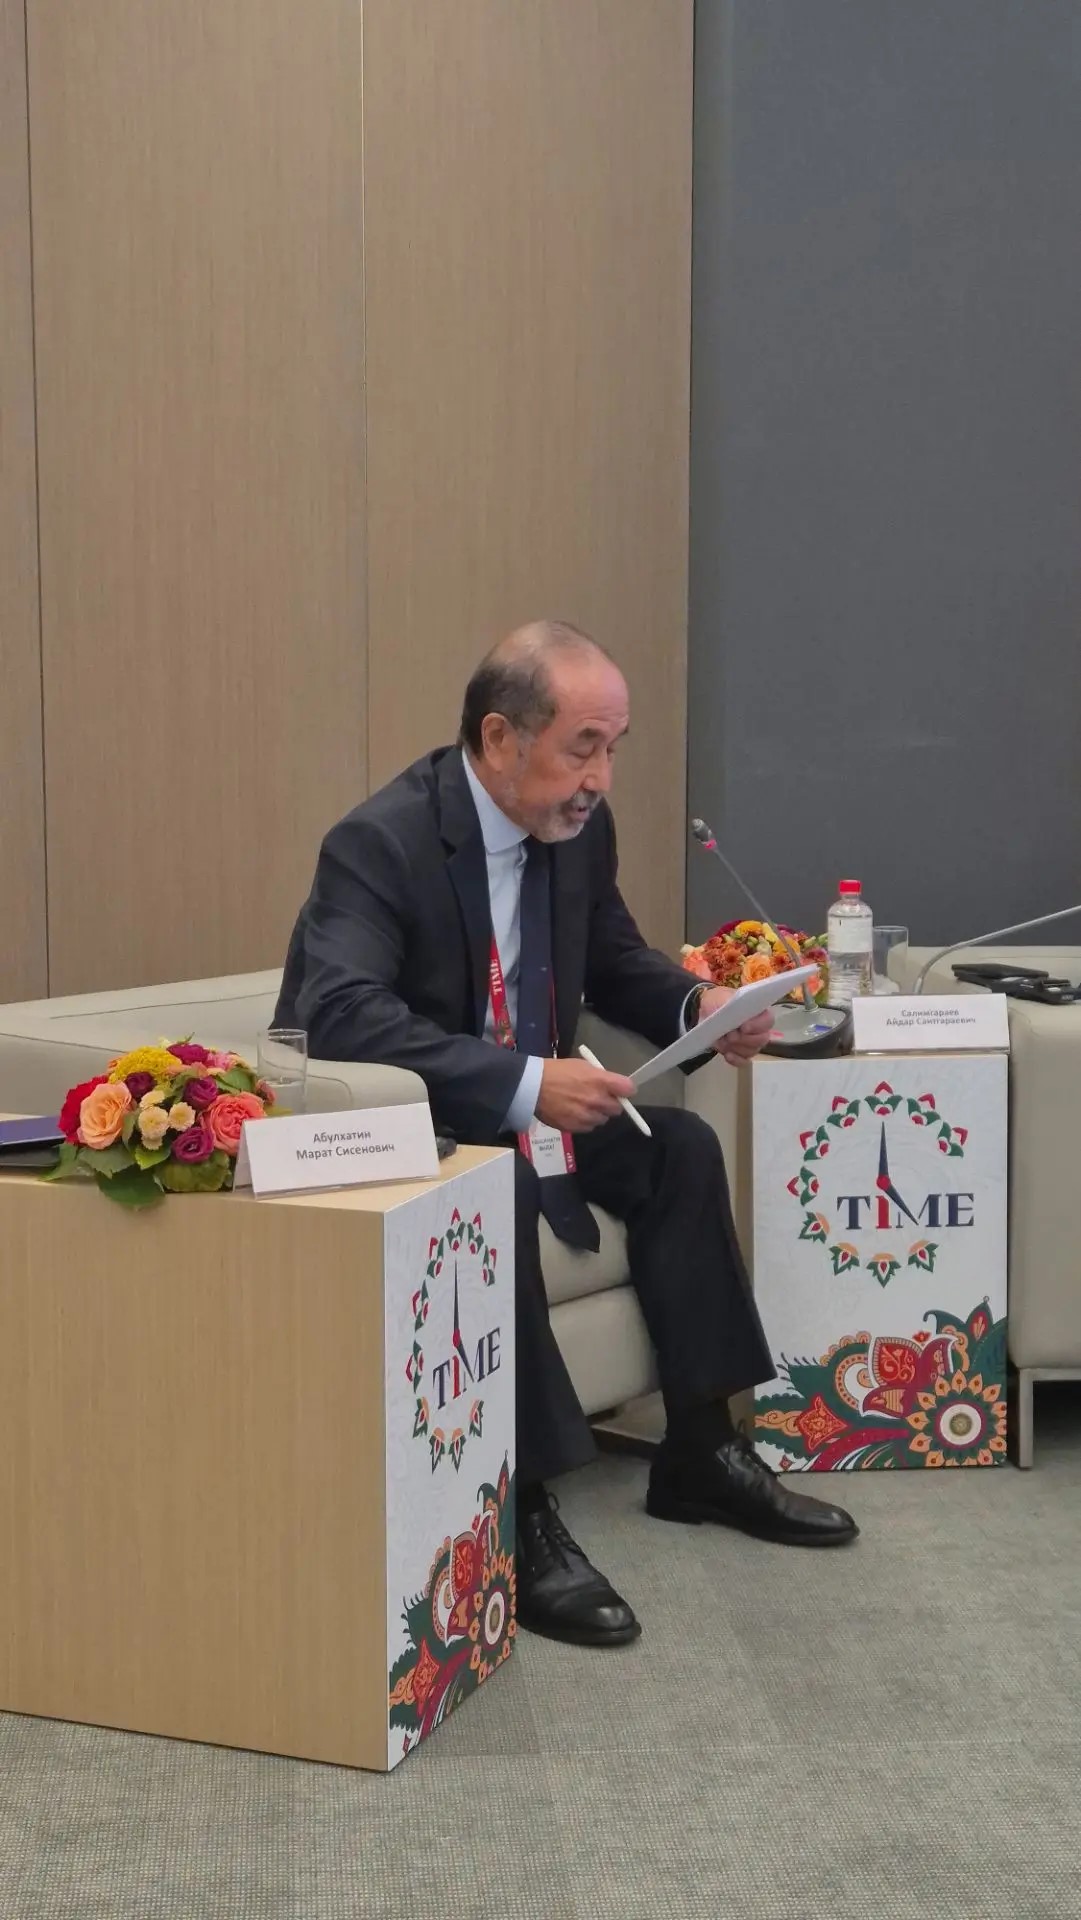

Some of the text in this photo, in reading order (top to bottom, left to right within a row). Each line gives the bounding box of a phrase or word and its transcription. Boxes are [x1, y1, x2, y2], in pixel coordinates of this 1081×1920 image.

[886, 1017, 914, 1026] Айдар
[313, 1131, 371, 1144] Абулхатин
[296, 1144, 395, 1161] Марат Сисенович
[836, 1192, 975, 1230] TIME
[432, 1327, 500, 1410] TIME
